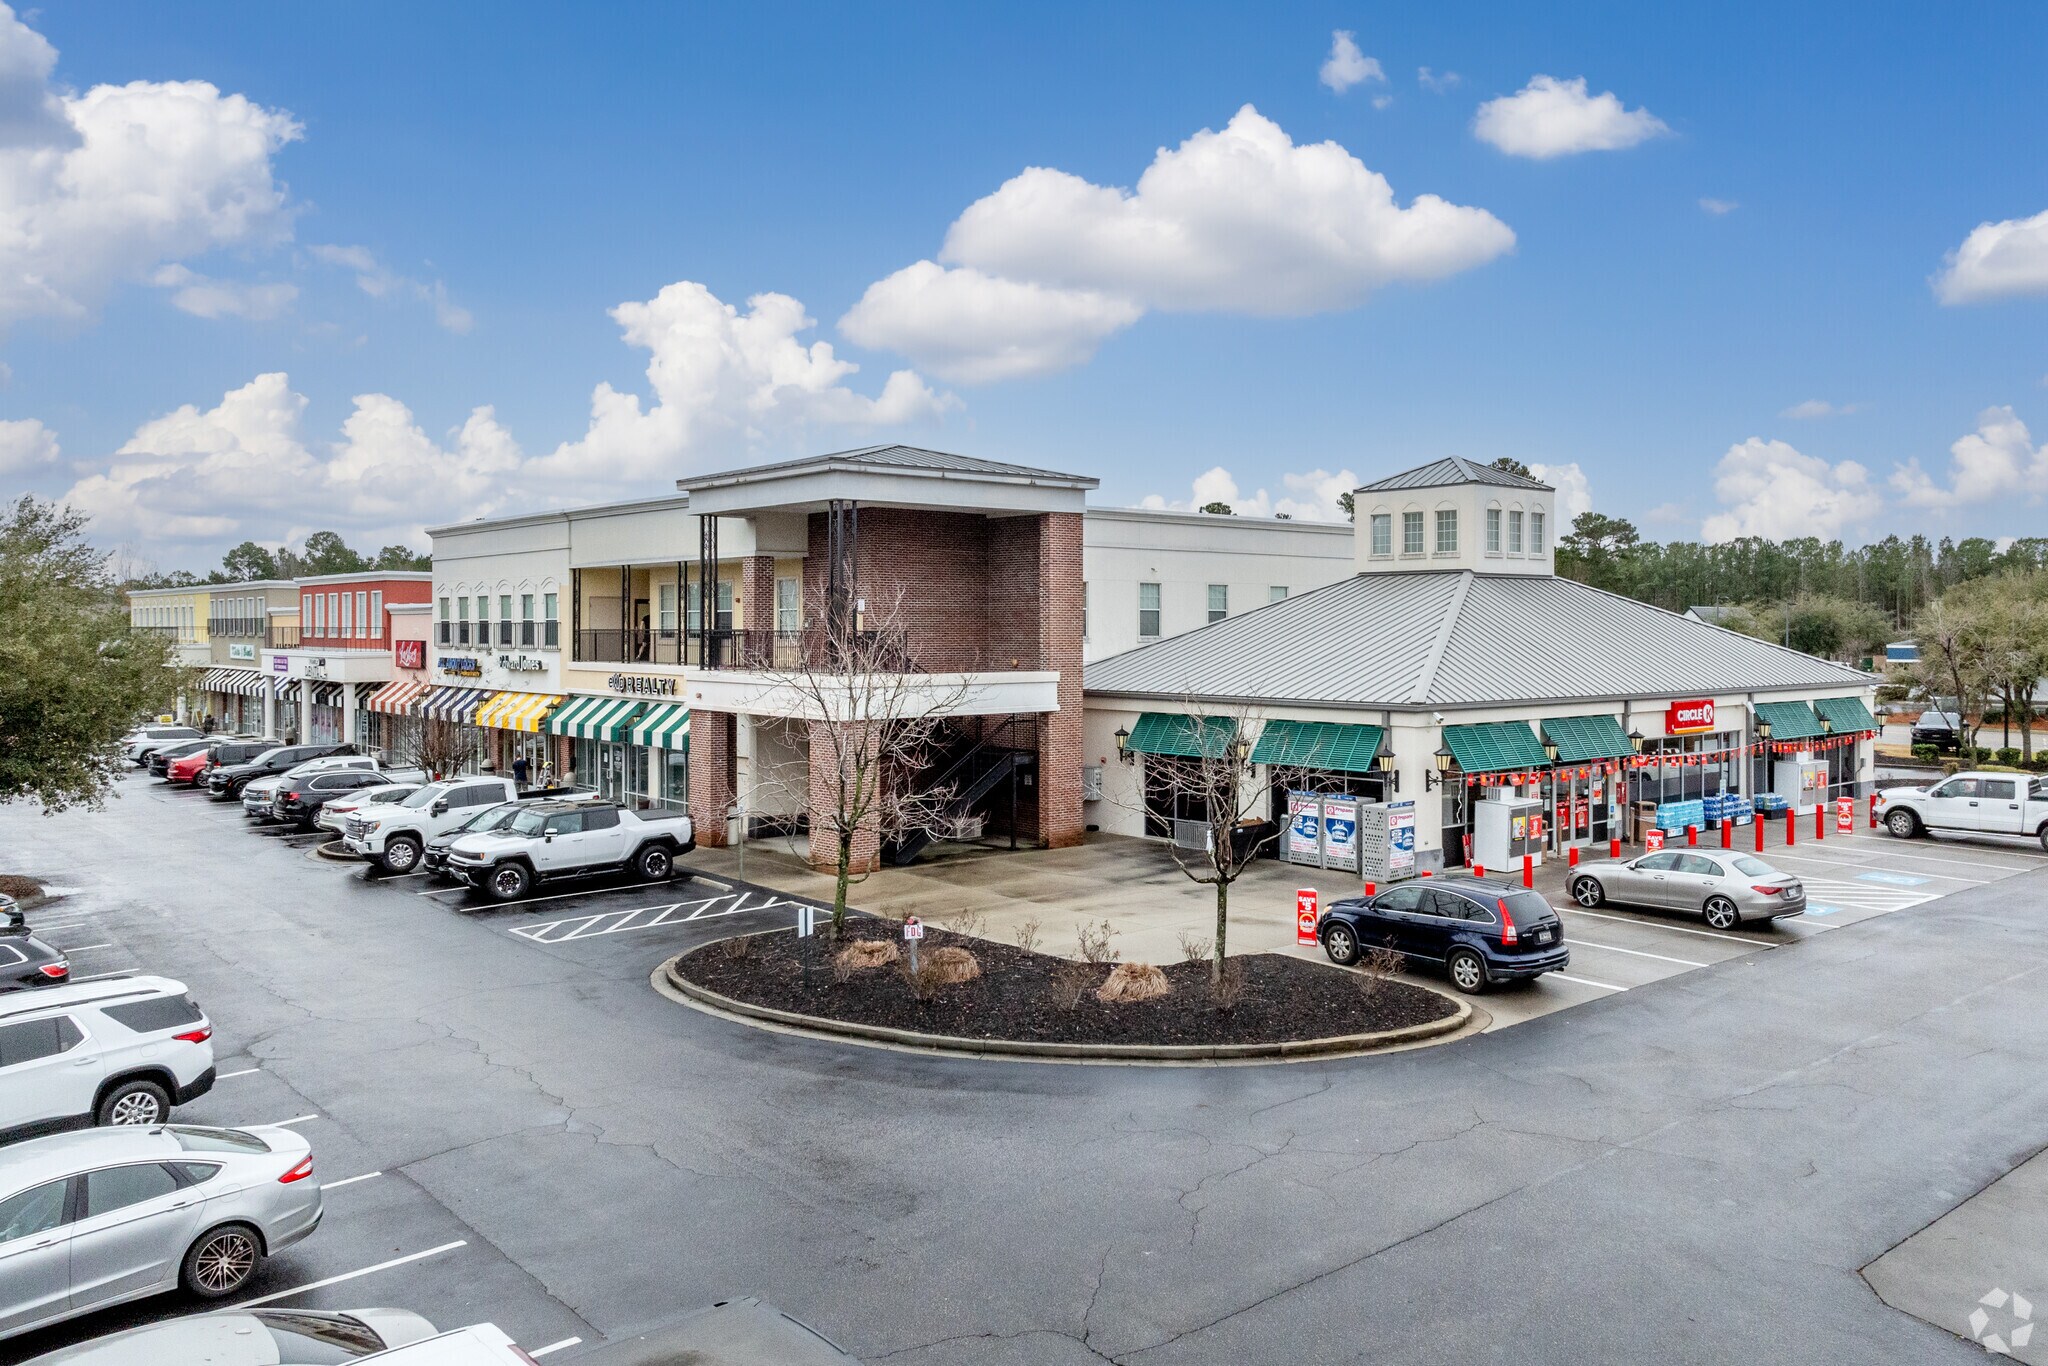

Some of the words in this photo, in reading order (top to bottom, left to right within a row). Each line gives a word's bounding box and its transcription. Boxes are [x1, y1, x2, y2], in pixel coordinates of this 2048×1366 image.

[520, 655, 542, 671] Jones
[627, 676, 676, 695] REALTY
[1677, 708, 1703, 722] CIRCLE
